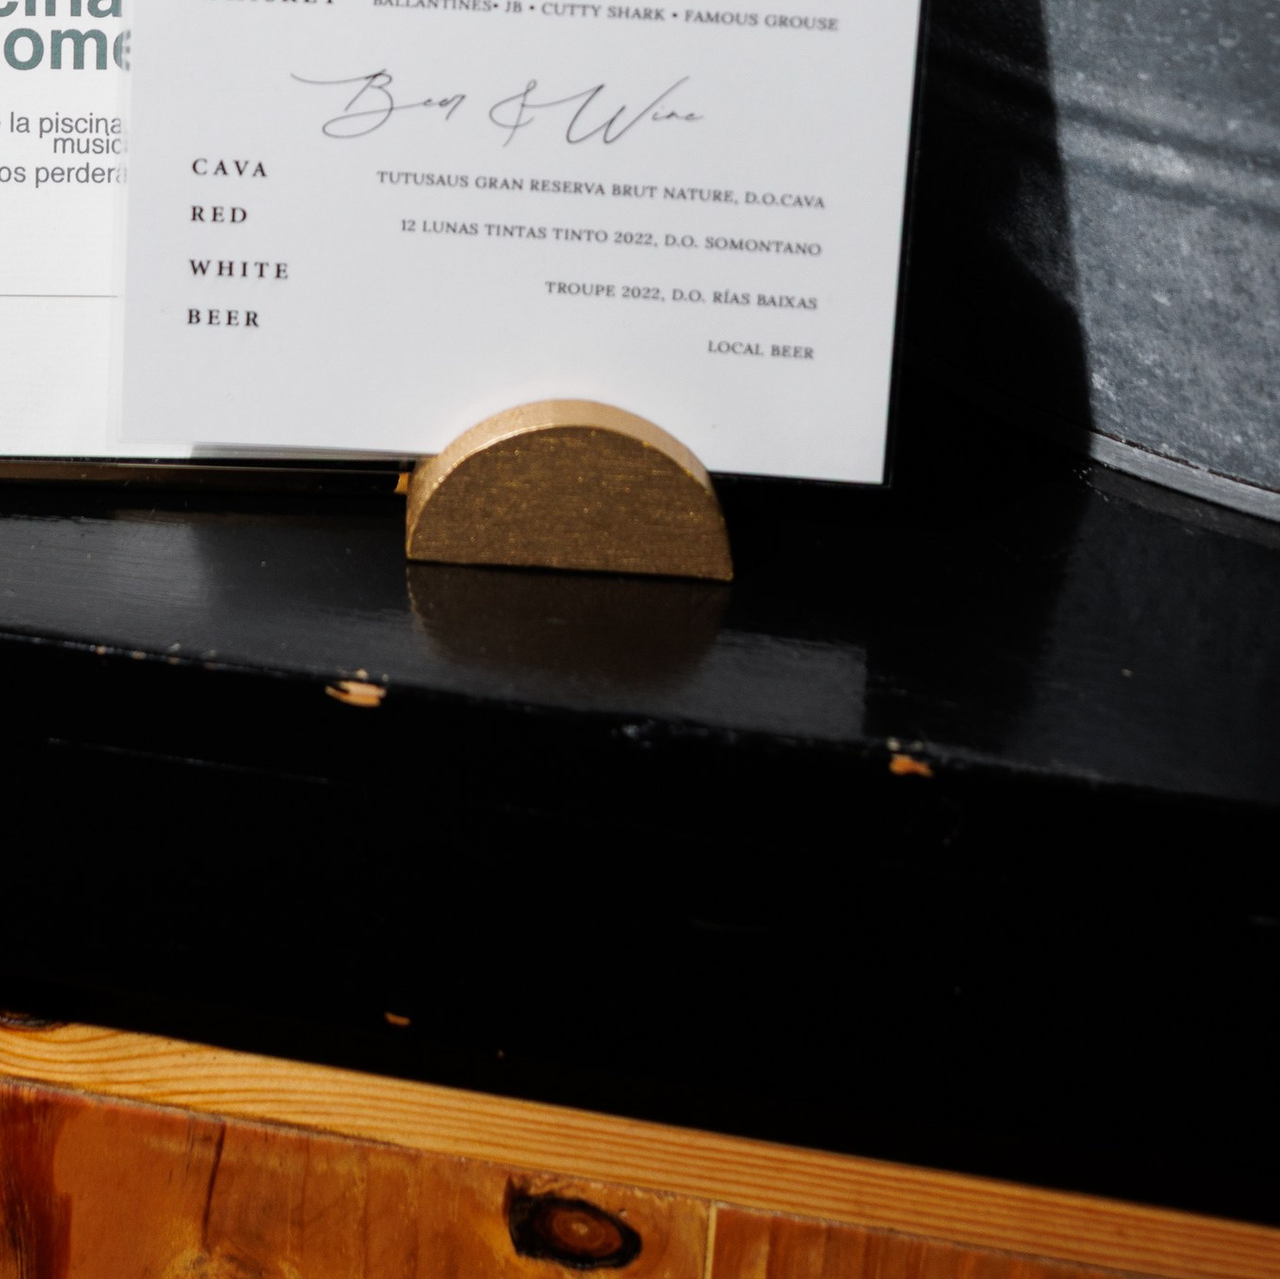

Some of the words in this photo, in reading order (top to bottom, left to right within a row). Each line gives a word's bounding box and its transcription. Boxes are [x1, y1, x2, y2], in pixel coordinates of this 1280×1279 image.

[505, 0, 523, 13] JB
[541, 2, 601, 17] CUTTY
[607, 6, 665, 21] SHARK
[685, 10, 758, 26] FAMOUS
[764, 14, 838, 32] GROUSE
[10, 111, 30, 133] la
[52, 135, 127, 154] music
[192, 159, 267, 177] CAVA
[377, 171, 469, 188] TUTUSAUS
[475, 176, 523, 190] GRAN
[530, 179, 605, 195] RESERVA
[612, 184, 658, 198] BRUT
[663, 187, 738, 204] NATURE,
[191, 206, 247, 223] RED
[402, 219, 416, 232] 12
[423, 220, 478, 235] LUNAS
[485, 224, 546, 239] TINTAS
[552, 228, 608, 242] TINTO
[614, 231, 658, 247] 2022,
[705, 237, 822, 256] SOMONTANO
[190, 260, 288, 279] WHITE
[545, 281, 615, 297] TROUPE
[622, 286, 665, 302] 2022,
[713, 289, 750, 305] RÍAS
[757, 294, 817, 310] BAIXAS
[188, 309, 259, 327] BEER
[708, 340, 763, 356] LOCAL
[771, 344, 814, 360] BEER
